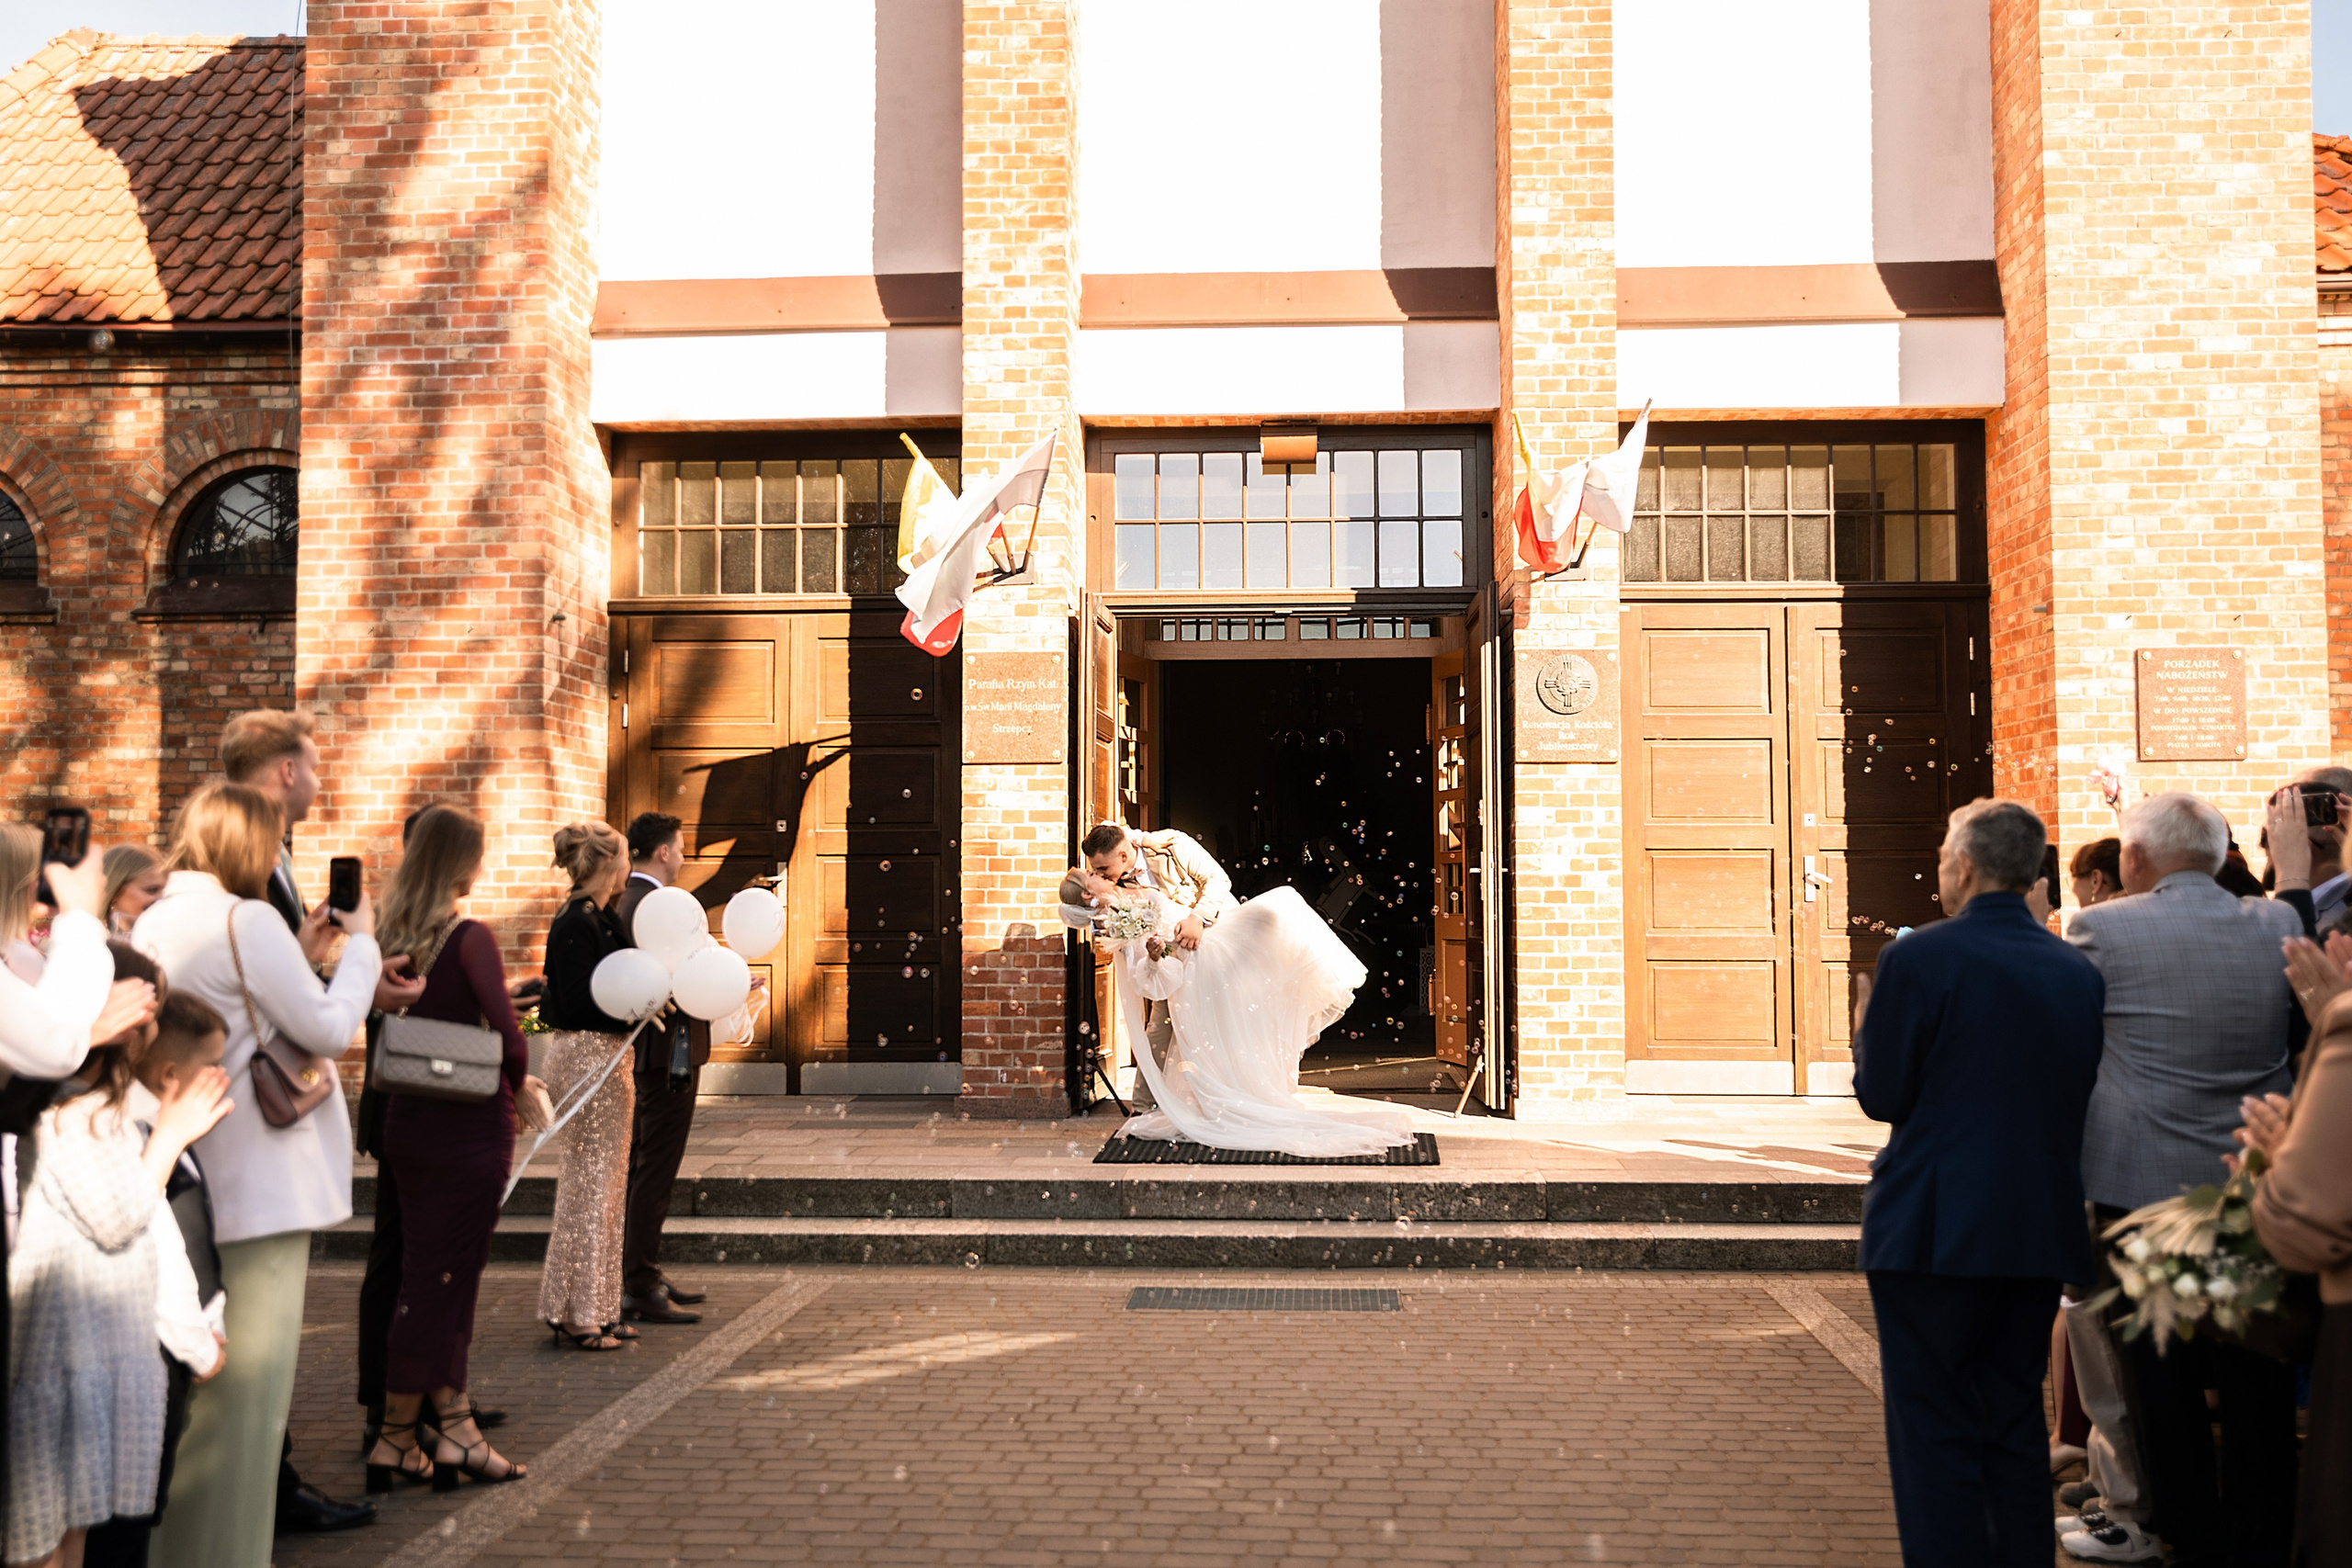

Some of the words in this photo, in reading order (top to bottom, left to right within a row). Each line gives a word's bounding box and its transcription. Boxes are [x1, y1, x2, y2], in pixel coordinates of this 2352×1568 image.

[2164, 660, 2220, 671] PORZĄDEK
[2156, 670, 2228, 680] NABOŻEŃSTW
[968, 679, 1004, 689] Parafia
[1007, 678, 1035, 692] Rzym
[1013, 701, 1061, 714] Magdaleny
[992, 723, 1033, 736] Strzepcz
[1522, 720, 1570, 730] Renowacja
[1574, 719, 1612, 728] Kościoła
[1558, 731, 1576, 739] Rok
